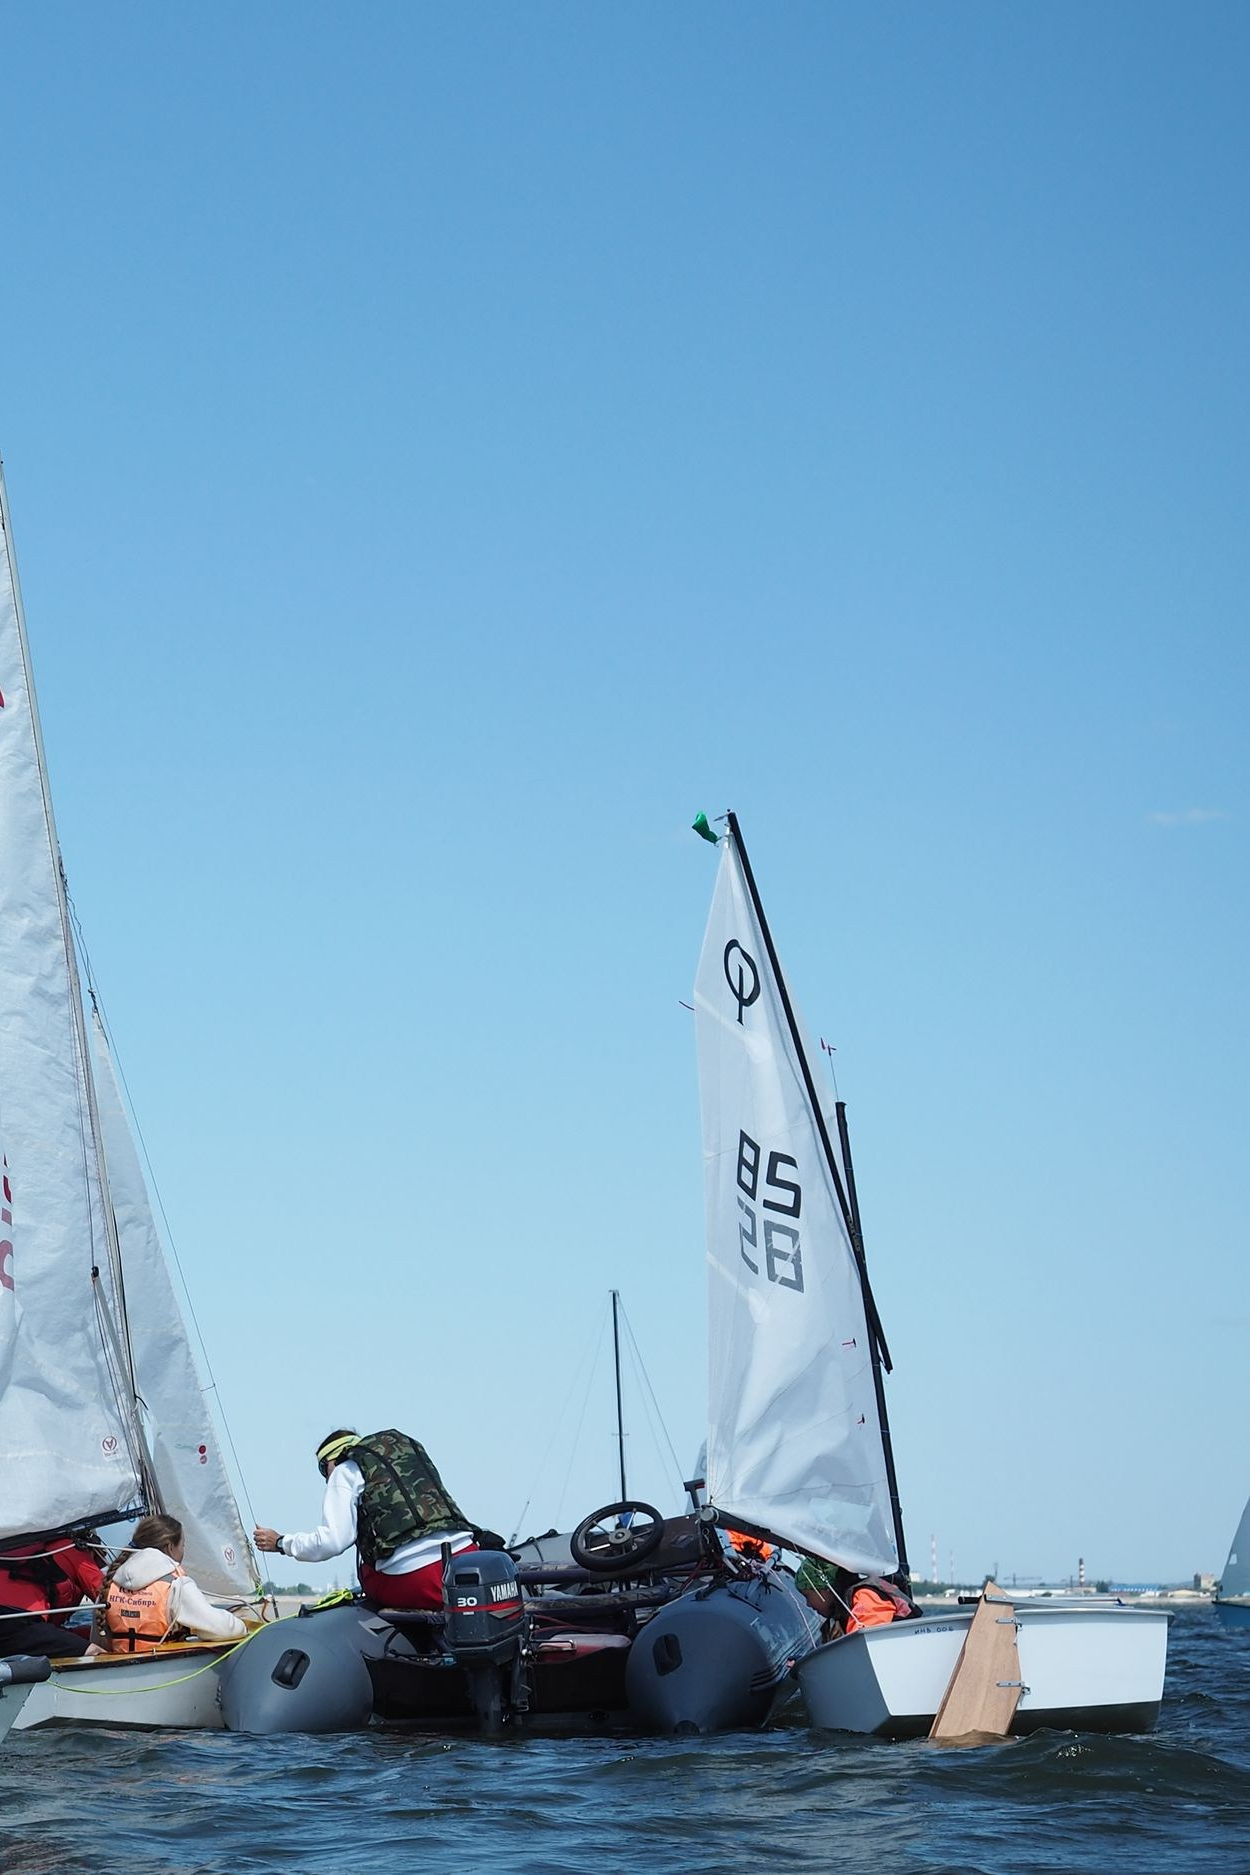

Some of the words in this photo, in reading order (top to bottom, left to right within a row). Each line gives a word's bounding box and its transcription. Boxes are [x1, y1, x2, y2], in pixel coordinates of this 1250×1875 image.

[736, 1128, 802, 1219] 85
[490, 1580, 519, 1602] YAMAHA
[109, 1594, 157, 1608] НГК-Сибирь
[457, 1596, 478, 1607] 30
